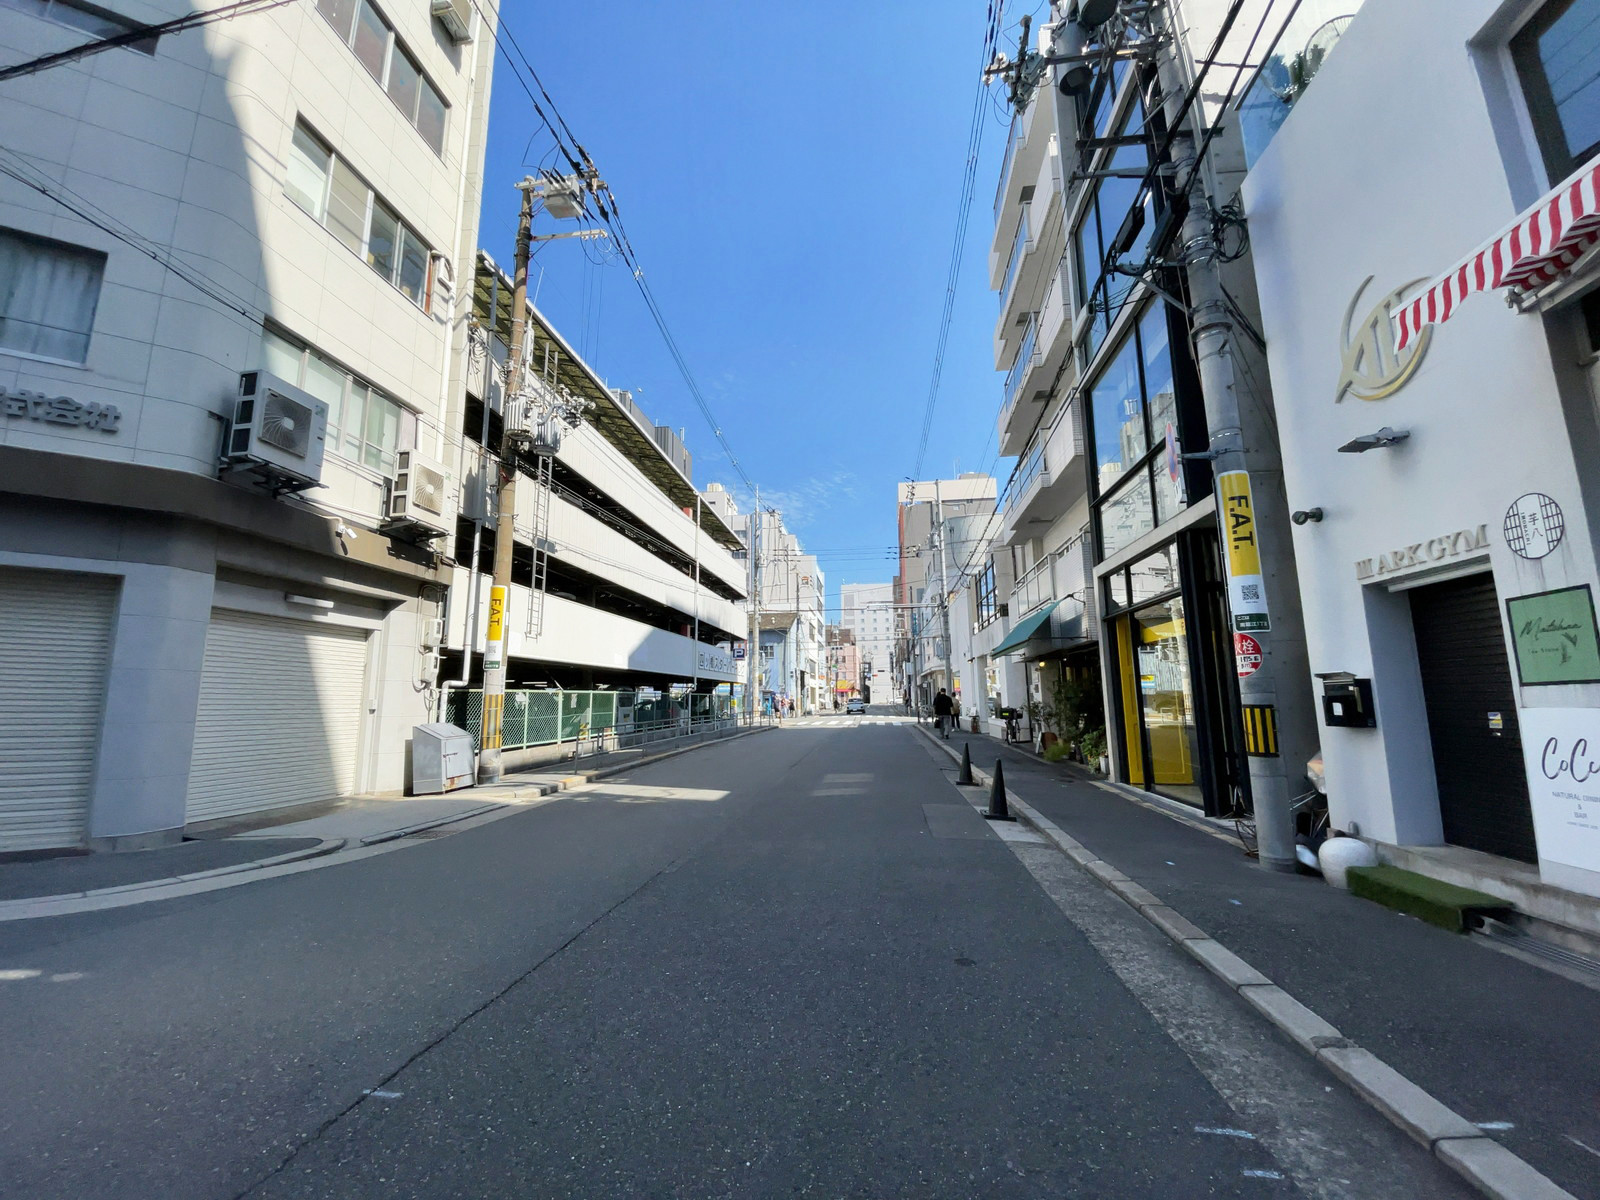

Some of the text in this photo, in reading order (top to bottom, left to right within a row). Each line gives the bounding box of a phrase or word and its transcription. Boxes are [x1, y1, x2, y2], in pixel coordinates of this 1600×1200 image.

[0, 385, 121, 432] 式会社
[1228, 495, 1254, 549] F.A.T.
[490, 598, 502, 627] F.A.T.
[734, 649, 744, 658] P
